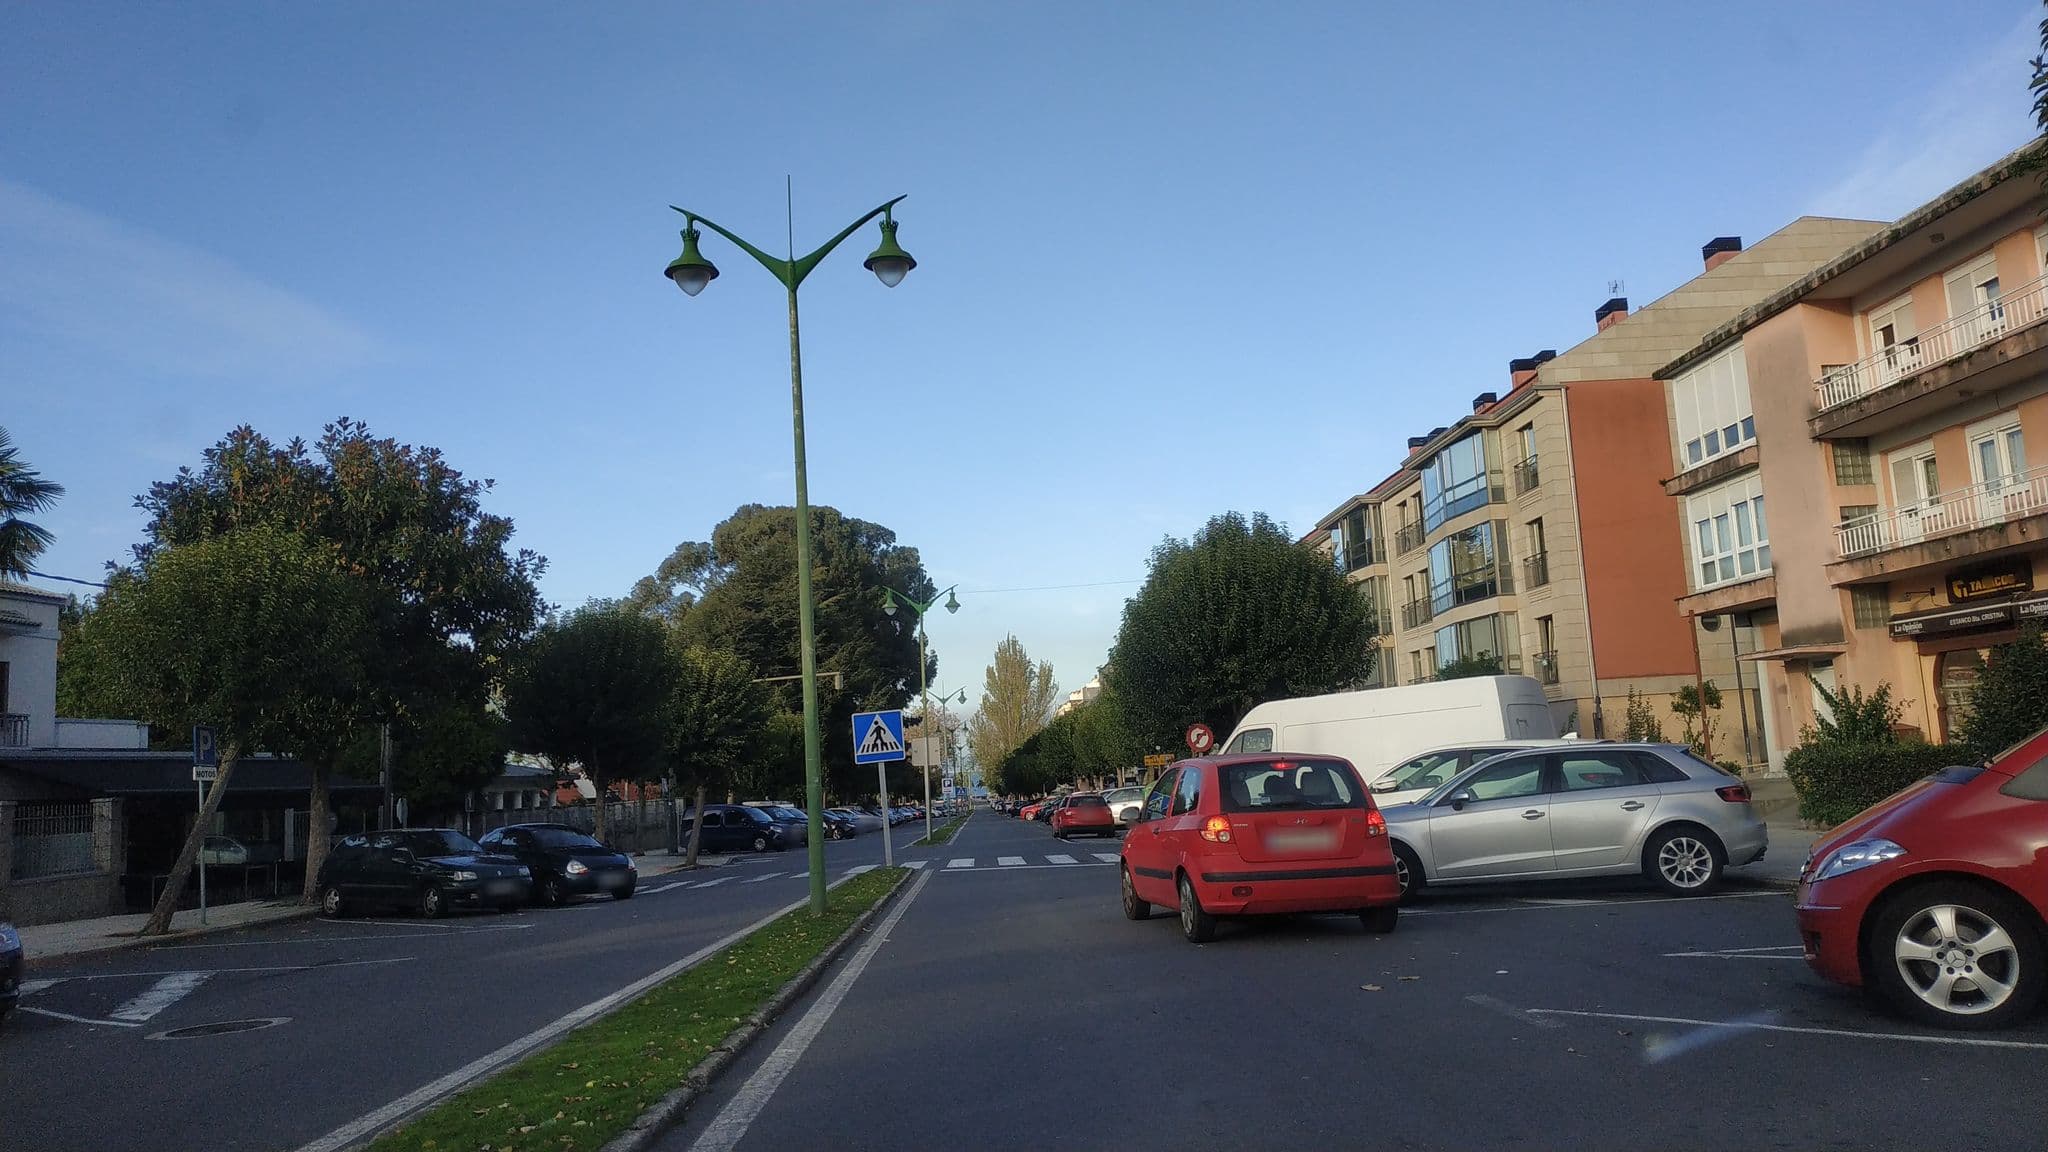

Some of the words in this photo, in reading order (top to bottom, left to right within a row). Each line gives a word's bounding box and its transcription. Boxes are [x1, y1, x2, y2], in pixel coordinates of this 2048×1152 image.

[1969, 574, 2014, 592] TAACOS
[2030, 602, 2048, 614] Opini
[200, 730, 211, 760] P
